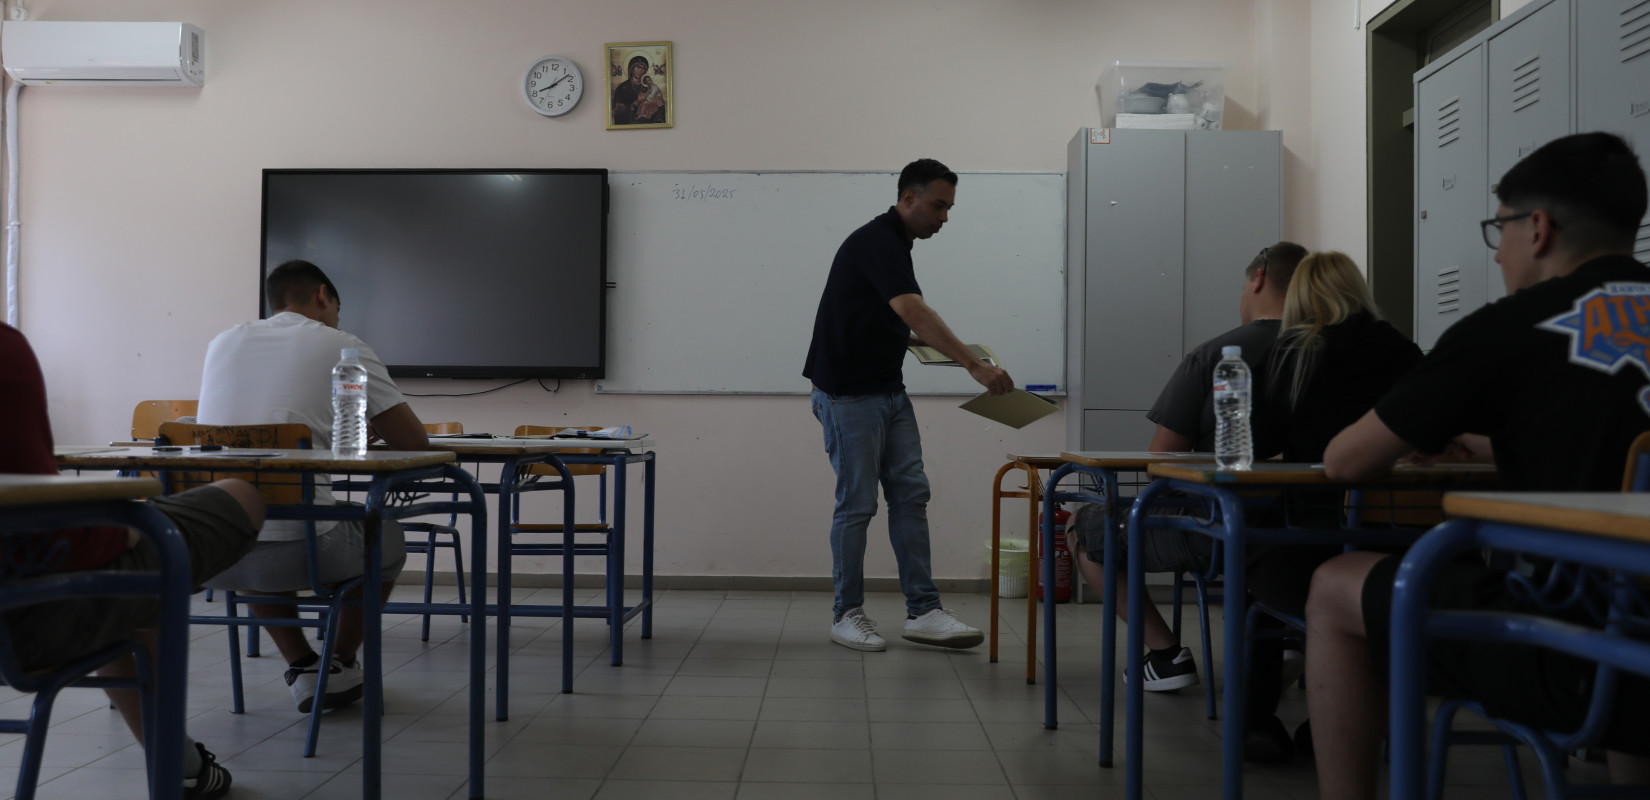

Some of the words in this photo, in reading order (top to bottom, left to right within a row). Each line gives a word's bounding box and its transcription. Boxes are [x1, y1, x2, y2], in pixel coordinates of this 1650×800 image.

[542, 65, 549, 73] 11
[551, 63, 560, 71] 12
[567, 75, 574, 83] 2
[530, 80, 537, 88] 9
[569, 84, 575, 92] 3
[547, 101, 553, 109] 6
[557, 99, 564, 107] 5
